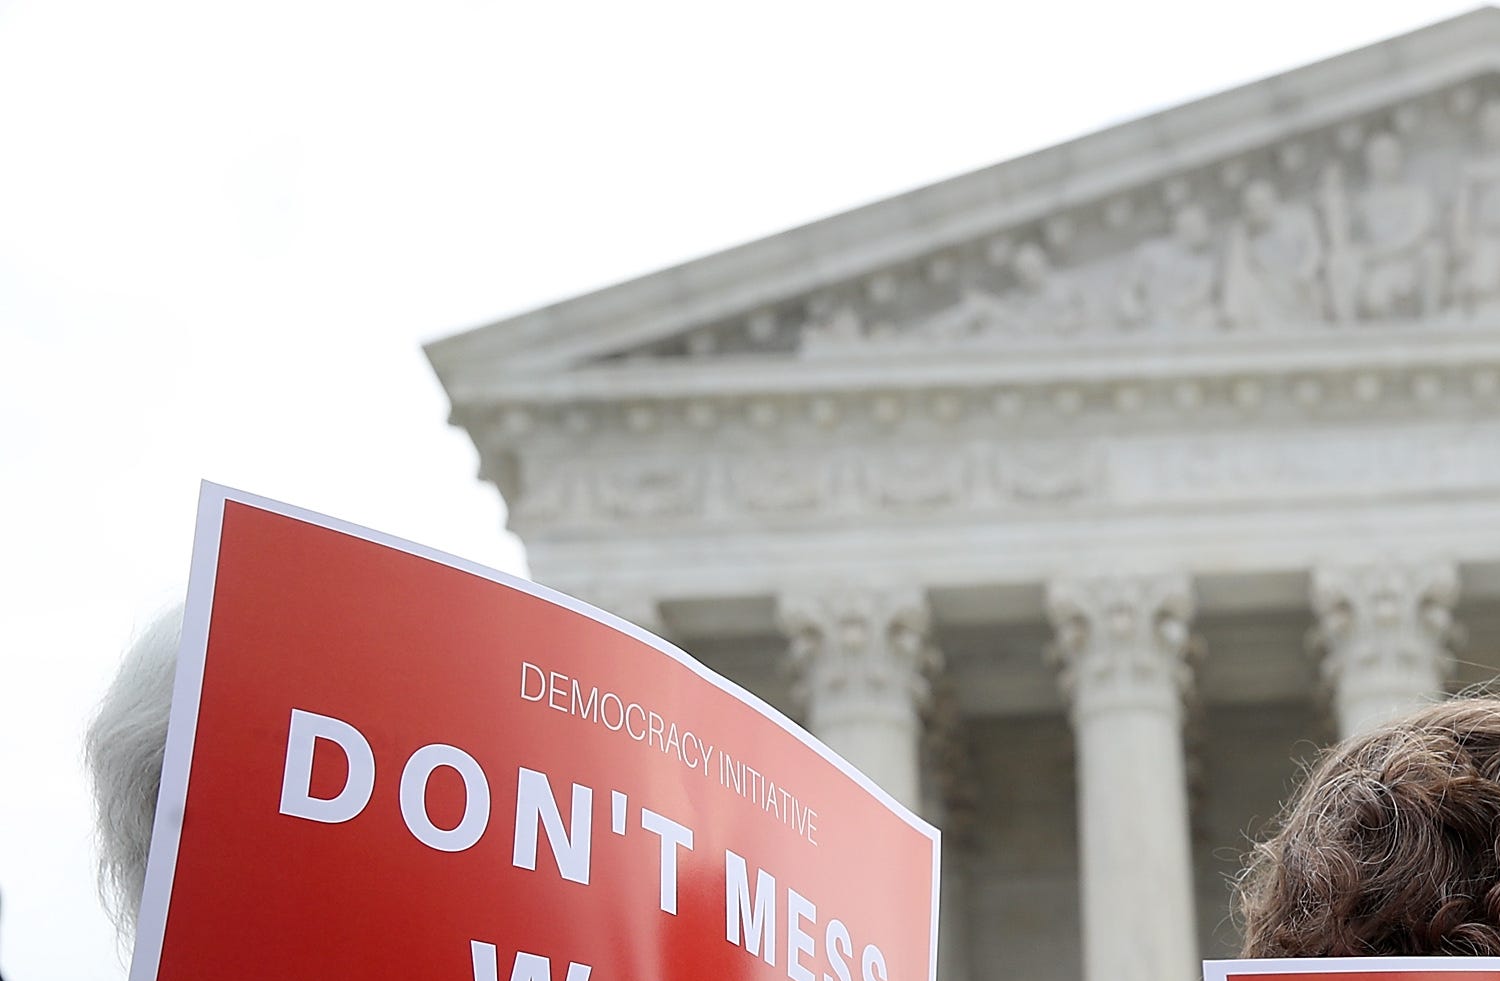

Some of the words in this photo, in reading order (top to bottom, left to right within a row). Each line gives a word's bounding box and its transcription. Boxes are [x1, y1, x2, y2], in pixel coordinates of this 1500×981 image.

[279, 707, 694, 915] DON'T
[521, 661, 714, 776] DEMOCRACY
[717, 750, 819, 846] INITIATIVE
